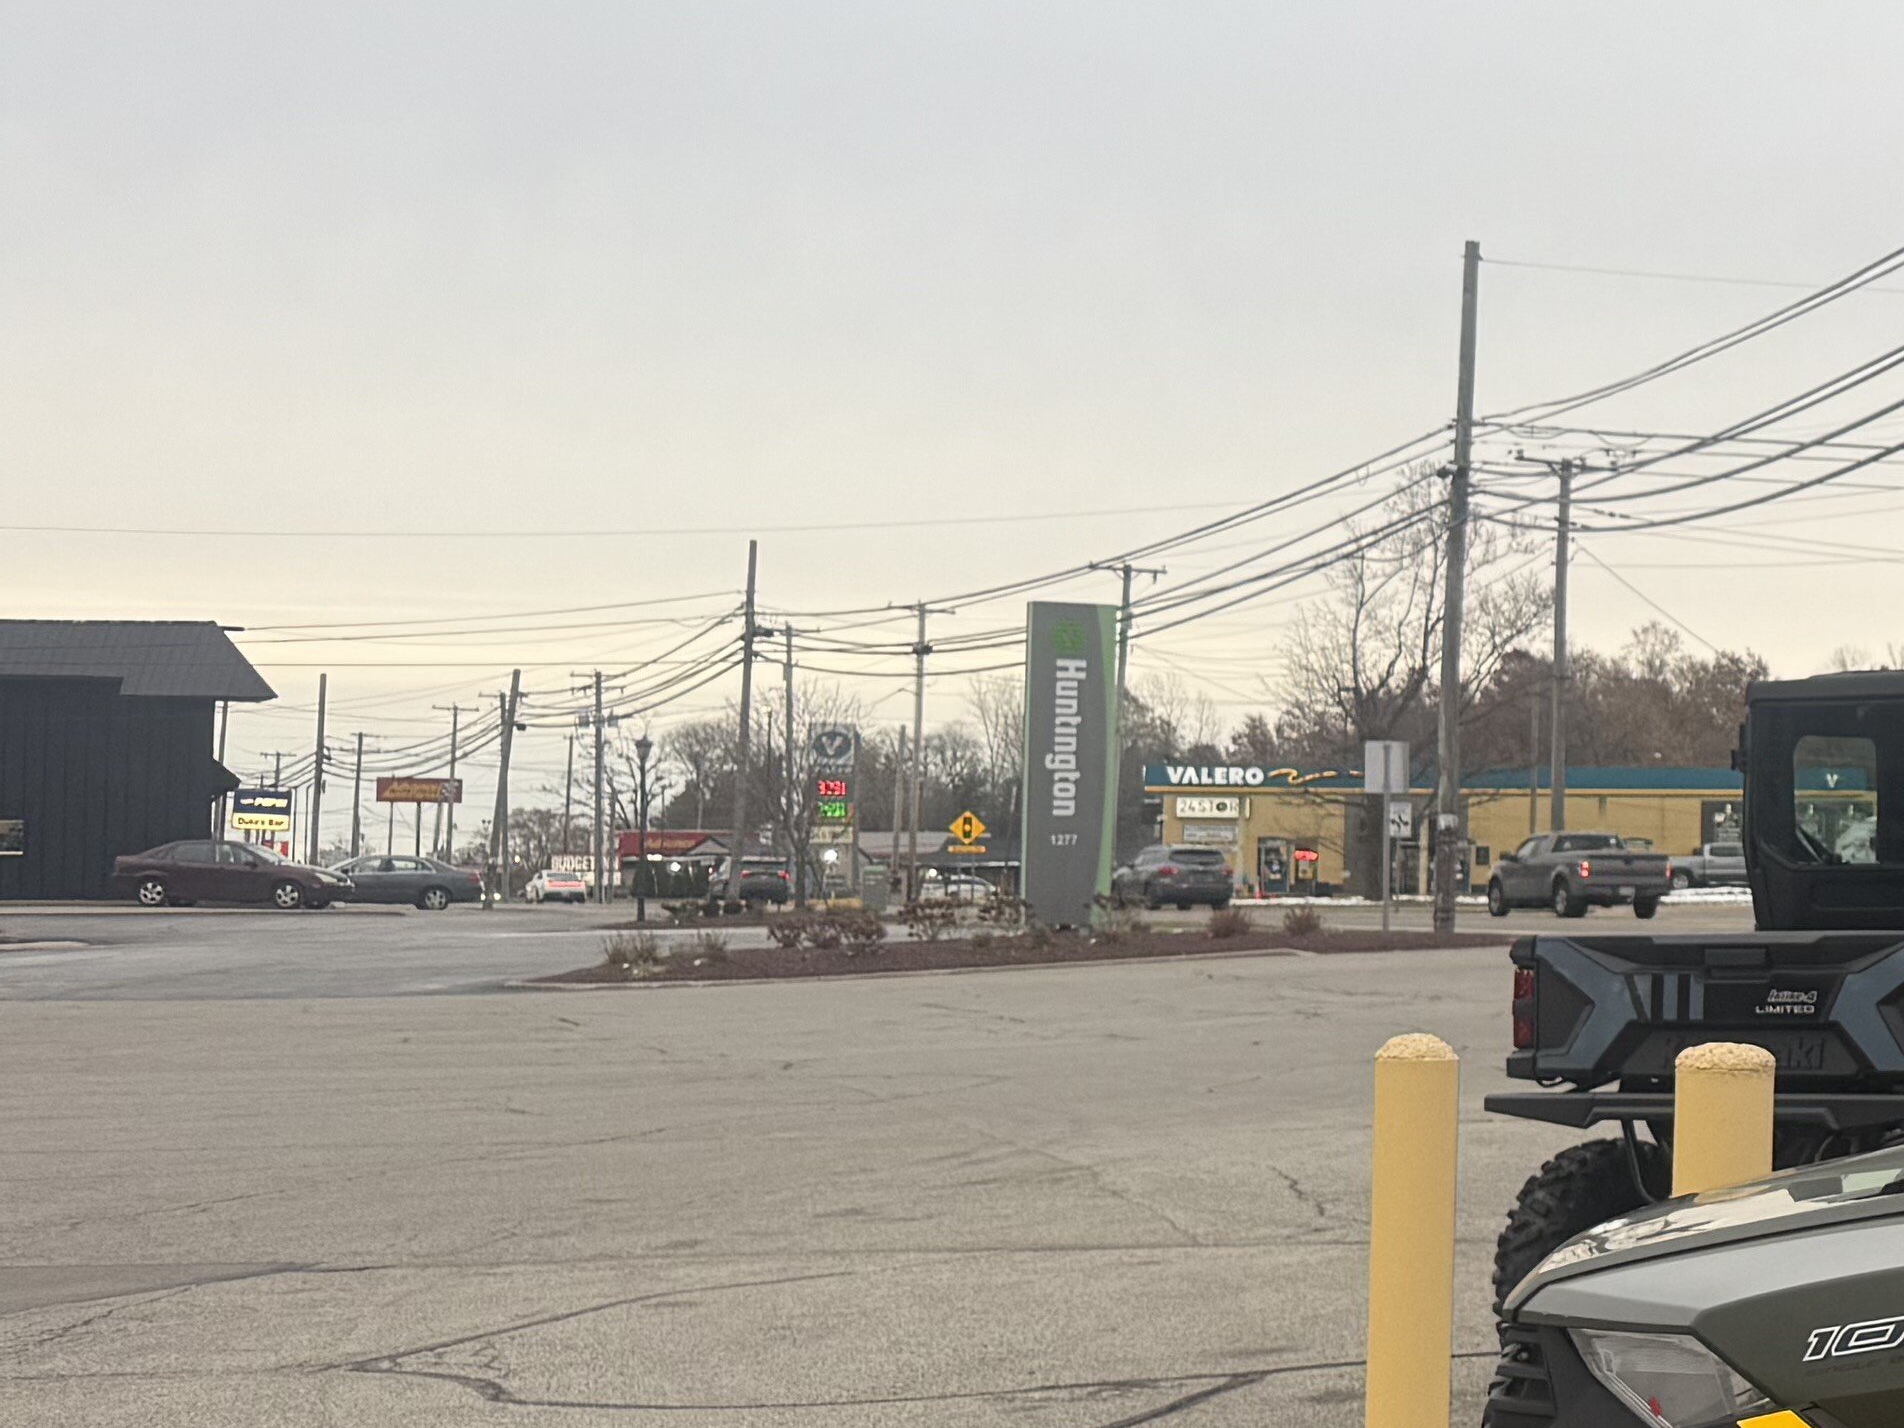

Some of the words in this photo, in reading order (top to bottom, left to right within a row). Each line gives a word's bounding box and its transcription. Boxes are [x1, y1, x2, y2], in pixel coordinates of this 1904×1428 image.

[1045, 658, 1087, 816] Huntington
[1166, 766, 1265, 786] VALERO
[1050, 834, 1078, 846] 1277
[1755, 1005, 1815, 1014] LIMITED
